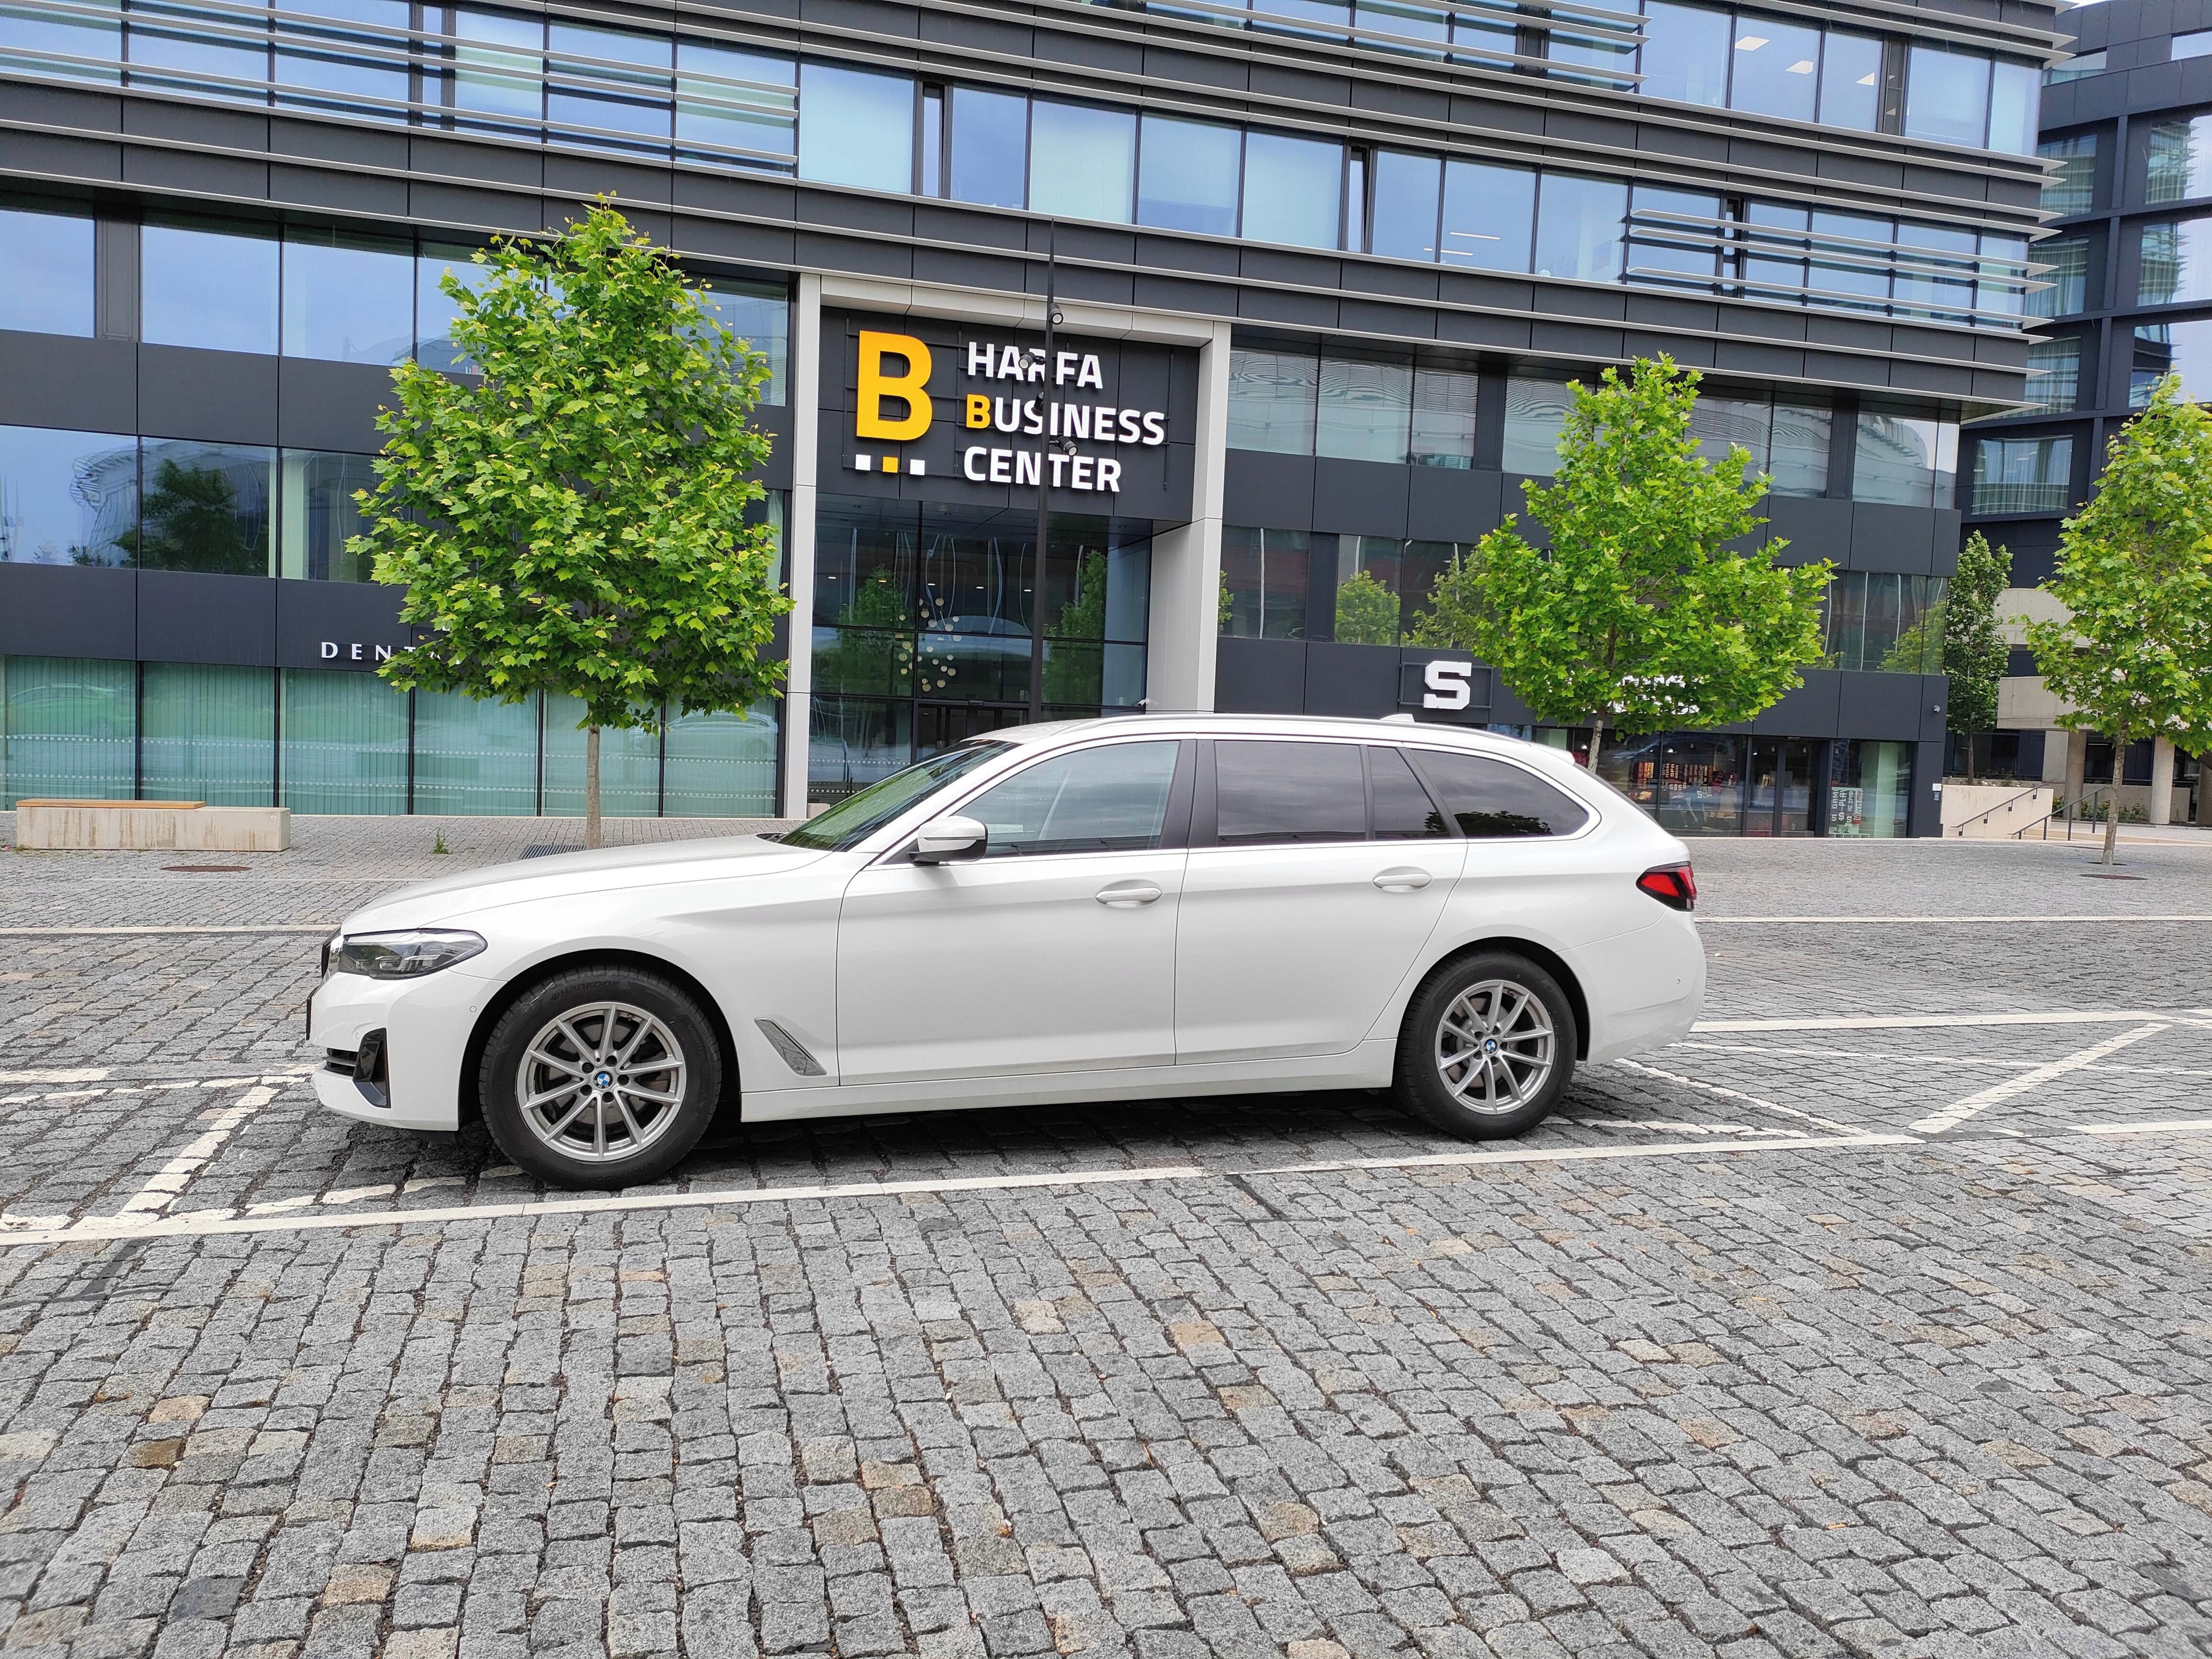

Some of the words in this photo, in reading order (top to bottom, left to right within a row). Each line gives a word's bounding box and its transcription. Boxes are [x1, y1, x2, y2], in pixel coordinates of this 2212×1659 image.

[857, 330, 933, 441] B
[968, 341, 1103, 389] HARFA
[966, 394, 1165, 446] BUSINESS
[964, 446, 1122, 493] CENTER
[1424, 660, 1472, 710] S
